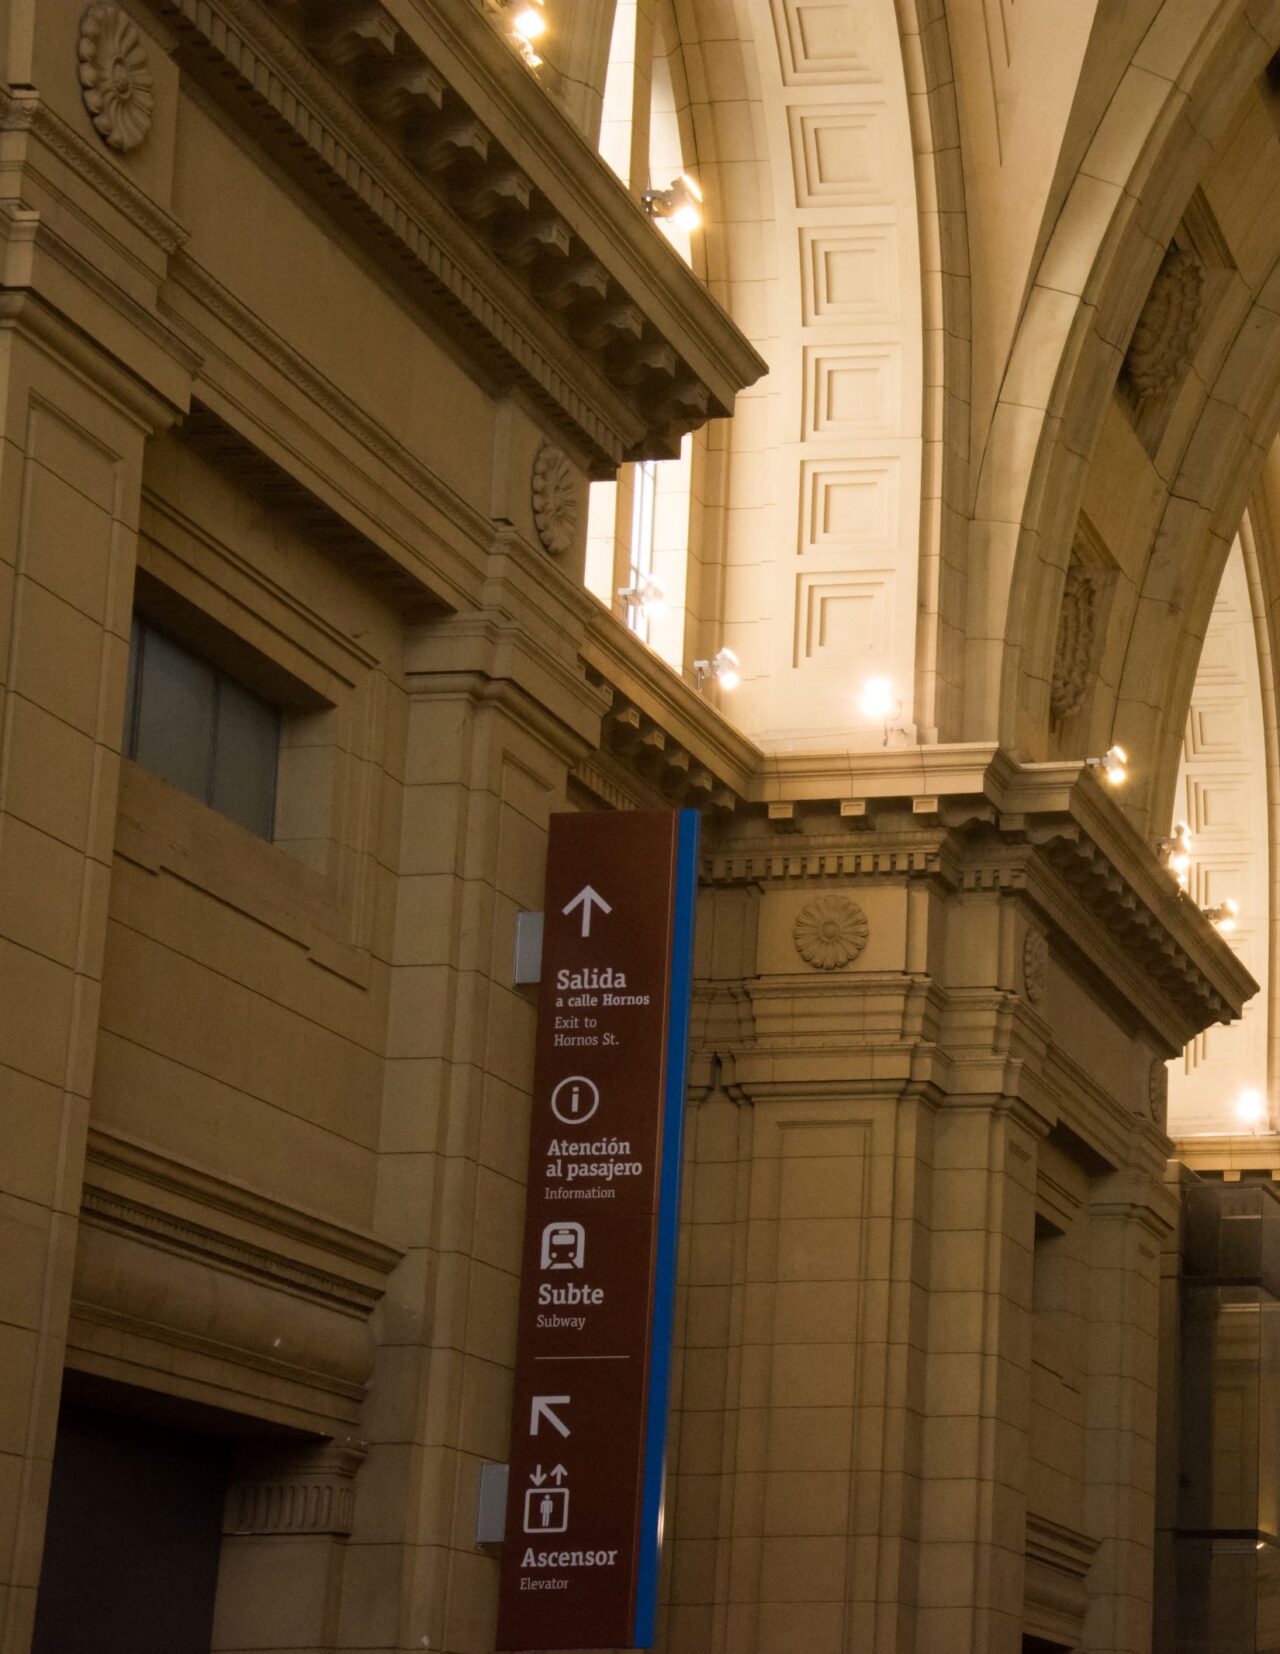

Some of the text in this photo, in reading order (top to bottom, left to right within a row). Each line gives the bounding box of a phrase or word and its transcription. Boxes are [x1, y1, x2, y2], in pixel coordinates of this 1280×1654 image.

[556, 967, 627, 991] Salida
[555, 993, 650, 1008] a calle Hornos
[553, 1015, 598, 1029] Exit to
[553, 1032, 620, 1047] Hornos St.
[546, 1136, 631, 1156] Atención
[545, 1157, 643, 1182] al pasajero
[544, 1185, 616, 1200] Information
[538, 1282, 605, 1305] Subte
[536, 1313, 587, 1331] Subway
[520, 1547, 618, 1568] Ascensor
[519, 1576, 569, 1591] Elevator
